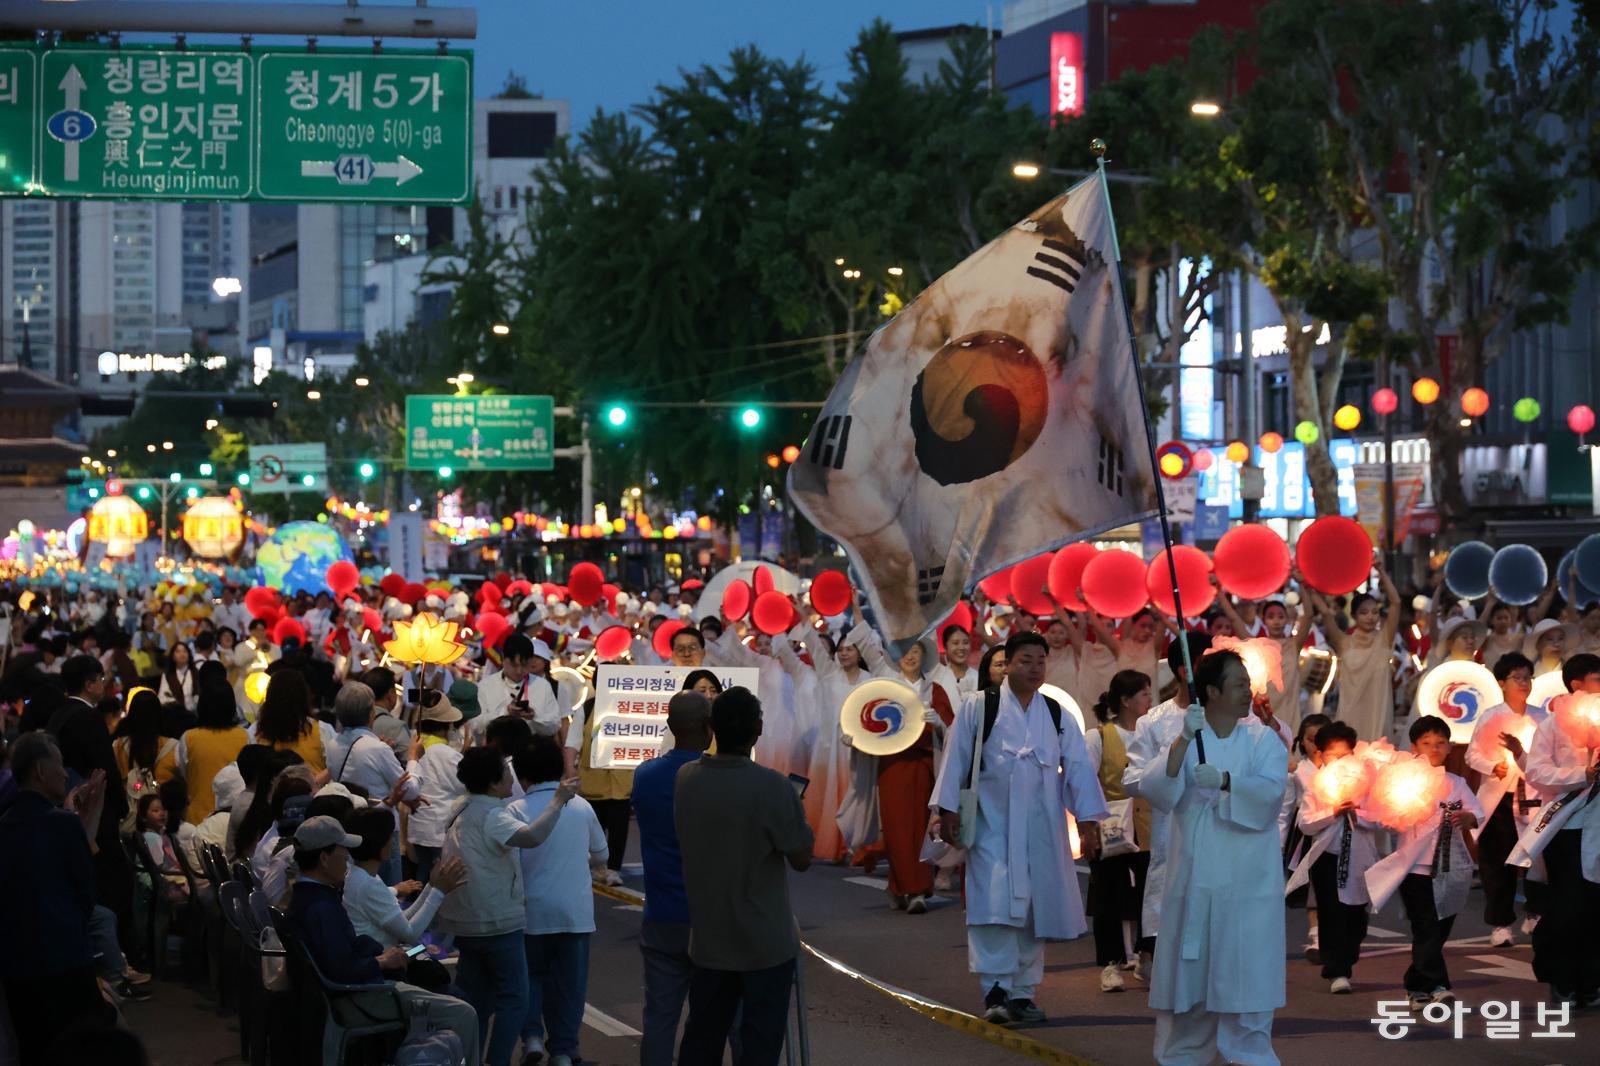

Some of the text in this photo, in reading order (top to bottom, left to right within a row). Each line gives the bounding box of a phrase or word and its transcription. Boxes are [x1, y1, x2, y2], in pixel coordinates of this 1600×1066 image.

[103, 57, 243, 95] 청량리역
[285, 70, 445, 113] 청계5가
[63, 115, 81, 137] 6
[101, 101, 243, 140] 흥인지문
[285, 116, 376, 149] Cheonggye
[104, 140, 229, 170] 興仁之門
[102, 171, 240, 193] Heunginjimun
[342, 158, 365, 180] 41
[607, 677, 676, 692] 마음의정원
[613, 747, 661, 761] 절로절
